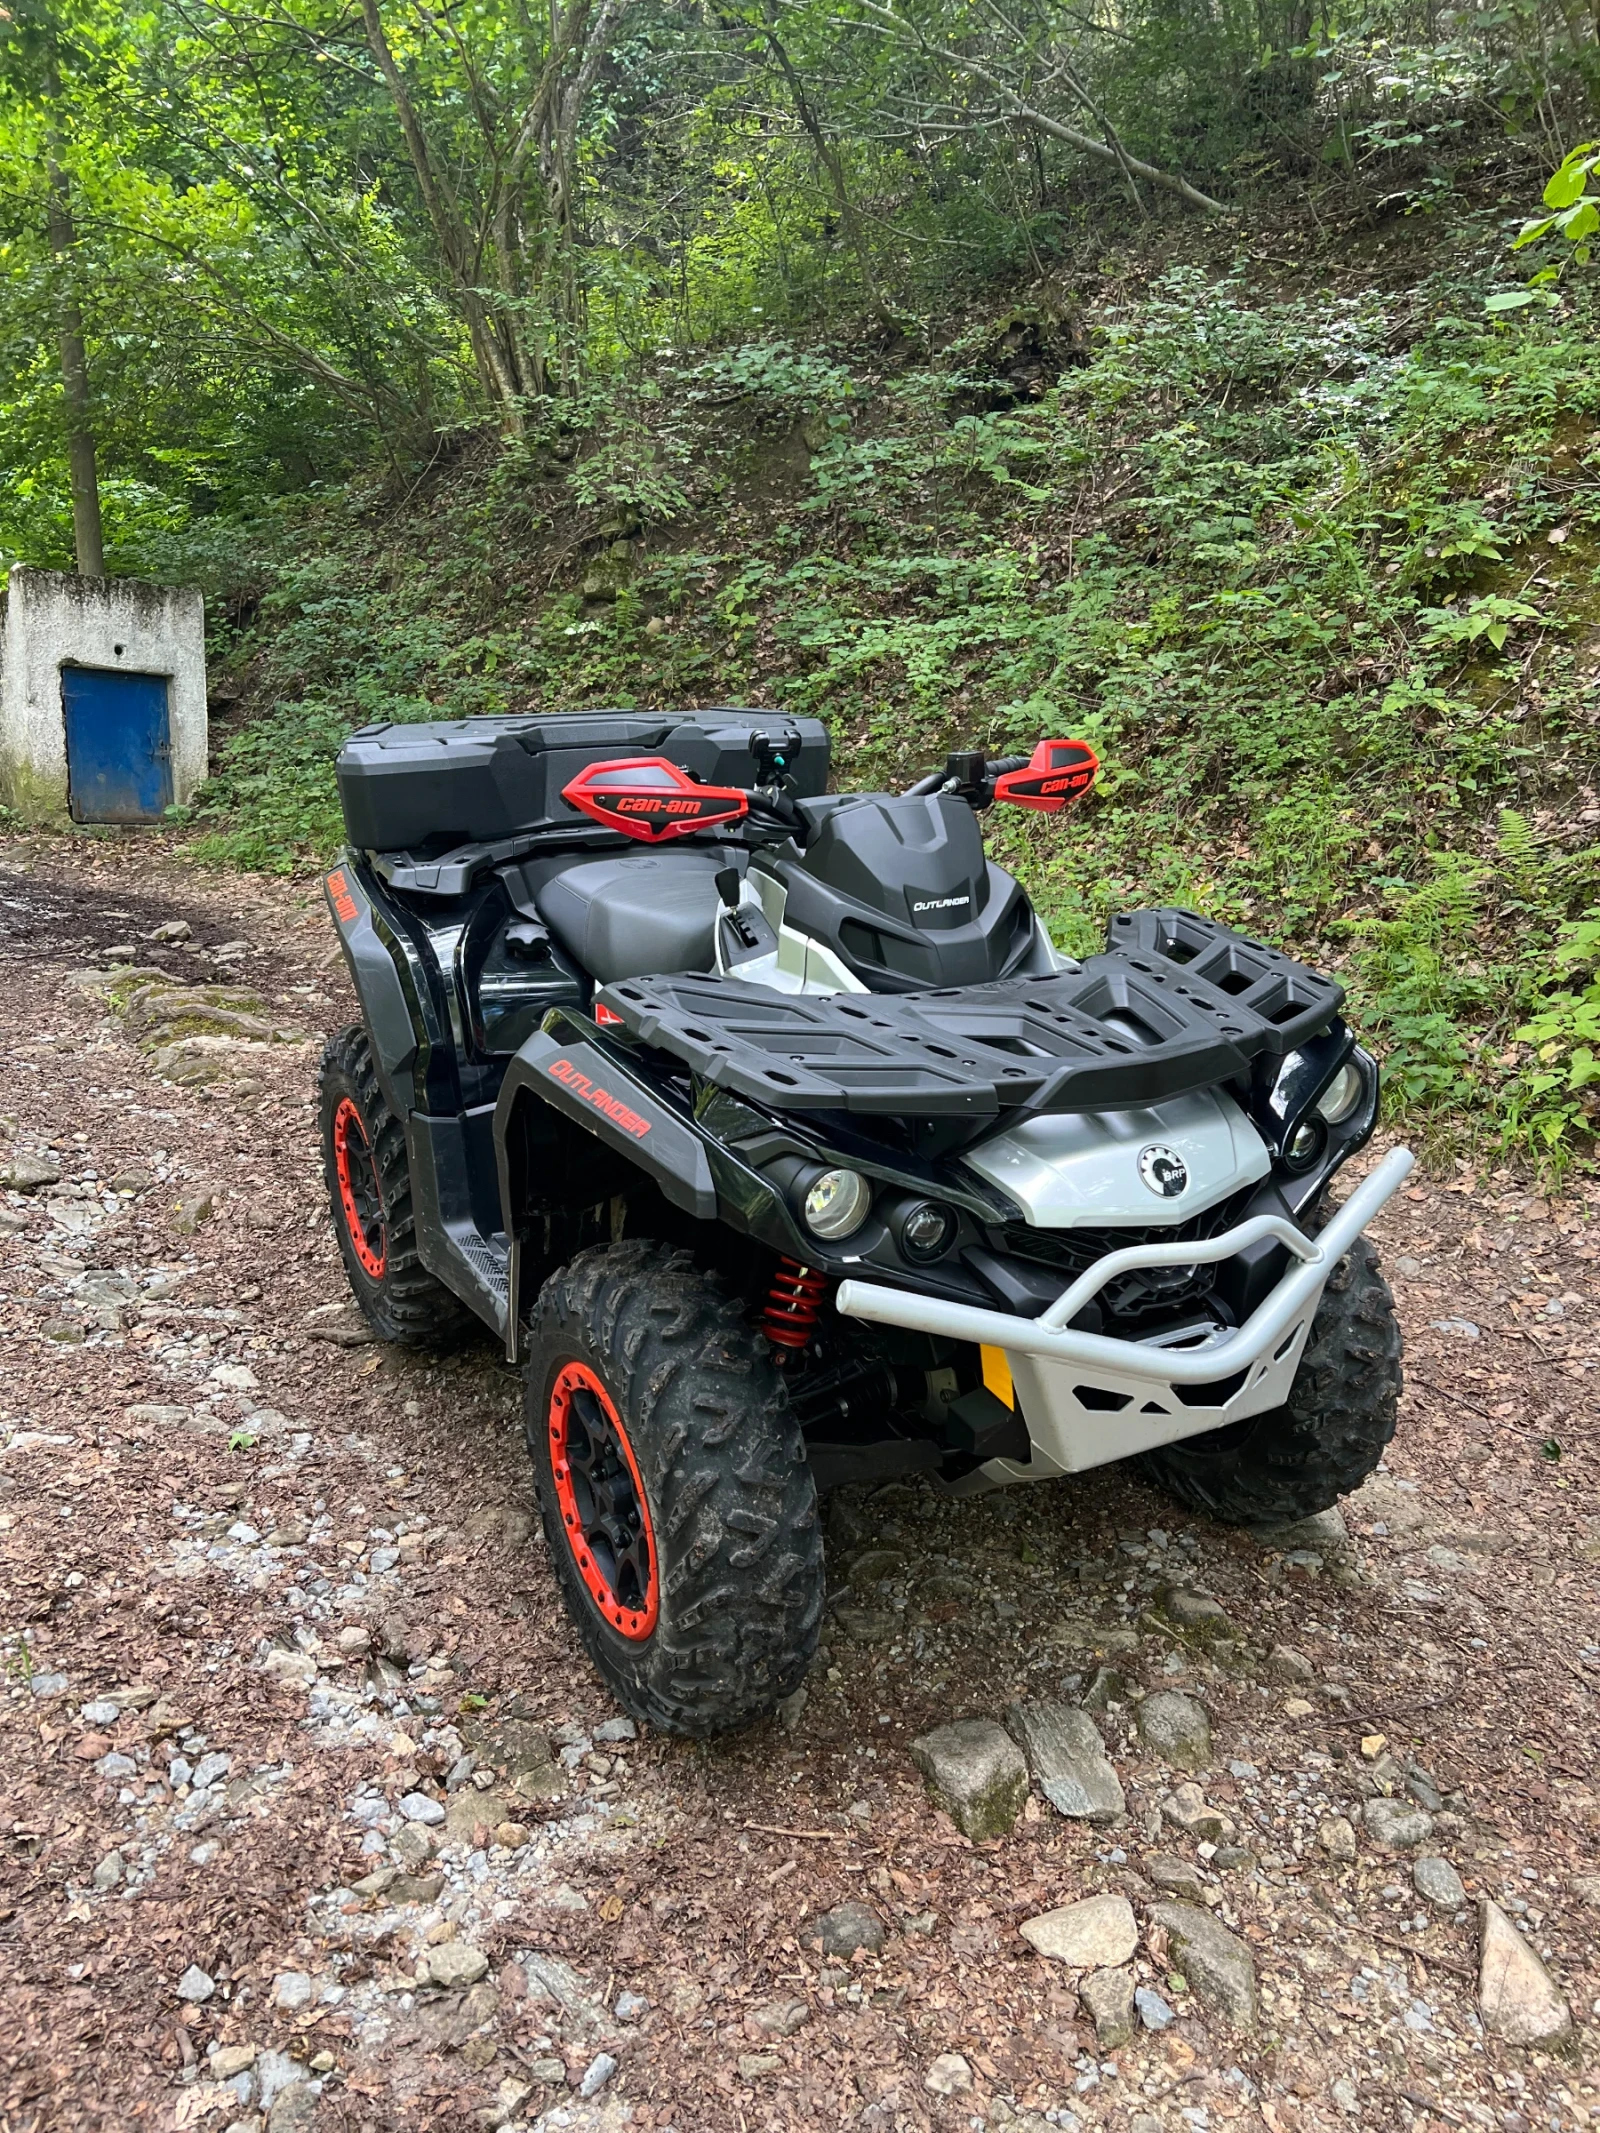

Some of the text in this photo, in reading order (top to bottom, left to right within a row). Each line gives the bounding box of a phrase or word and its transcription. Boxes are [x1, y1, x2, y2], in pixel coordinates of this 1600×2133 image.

[1040, 773, 1089, 794] can-am
[616, 797, 702, 814] can-am
[326, 870, 359, 923] can-am
[913, 896, 970, 911] OUTLANDER
[548, 1059, 652, 1139] OUTLANDER
[1162, 1168, 1186, 1182] BRP
